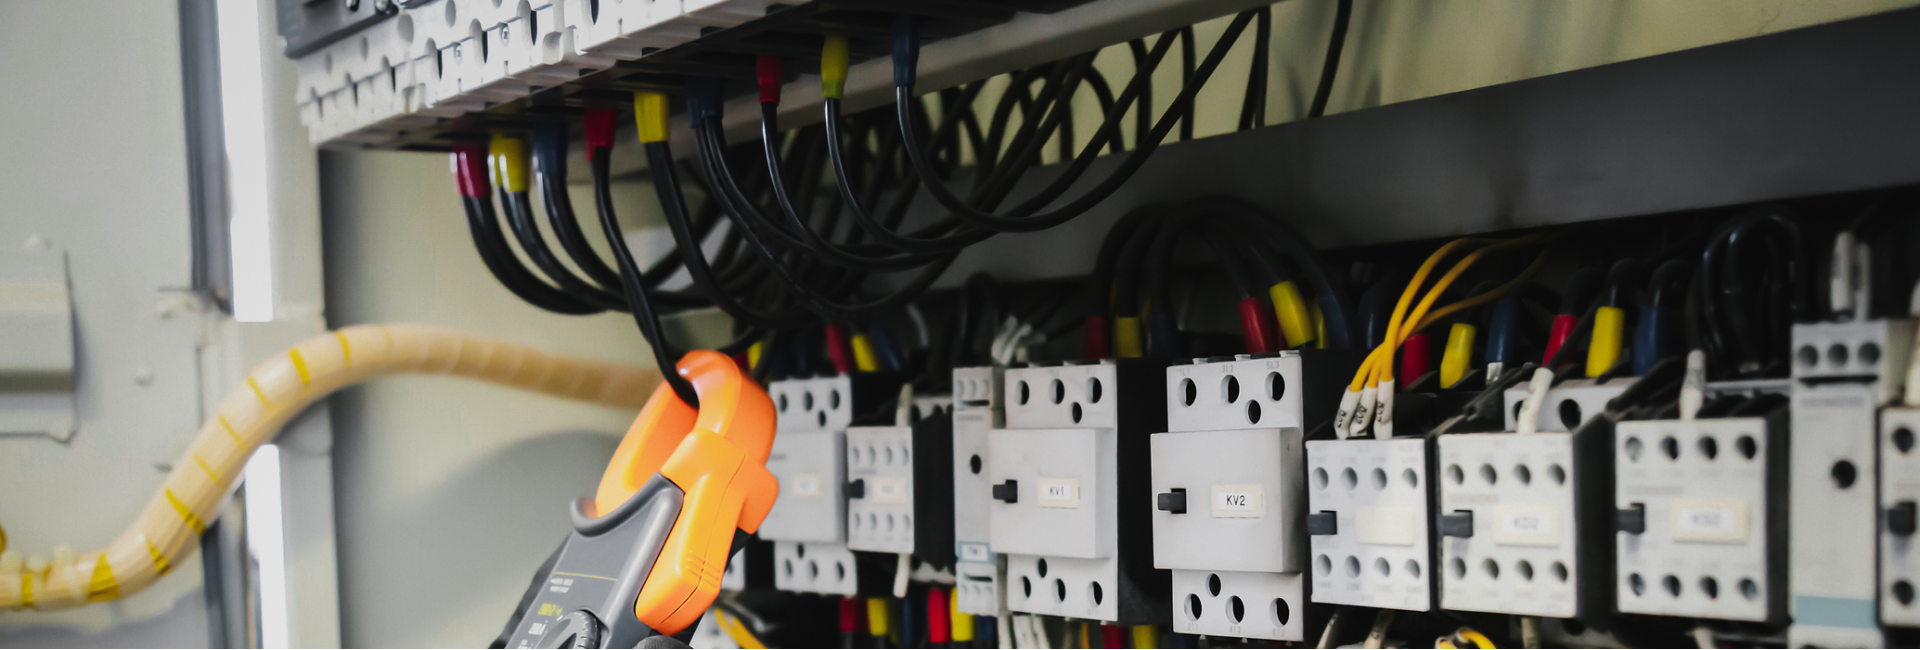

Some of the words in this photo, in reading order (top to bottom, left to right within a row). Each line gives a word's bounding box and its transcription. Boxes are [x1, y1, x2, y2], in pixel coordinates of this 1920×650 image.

[1222, 365, 1234, 373] 3L2
[1049, 486, 1064, 496] KV1
[1226, 494, 1246, 506] KV2
